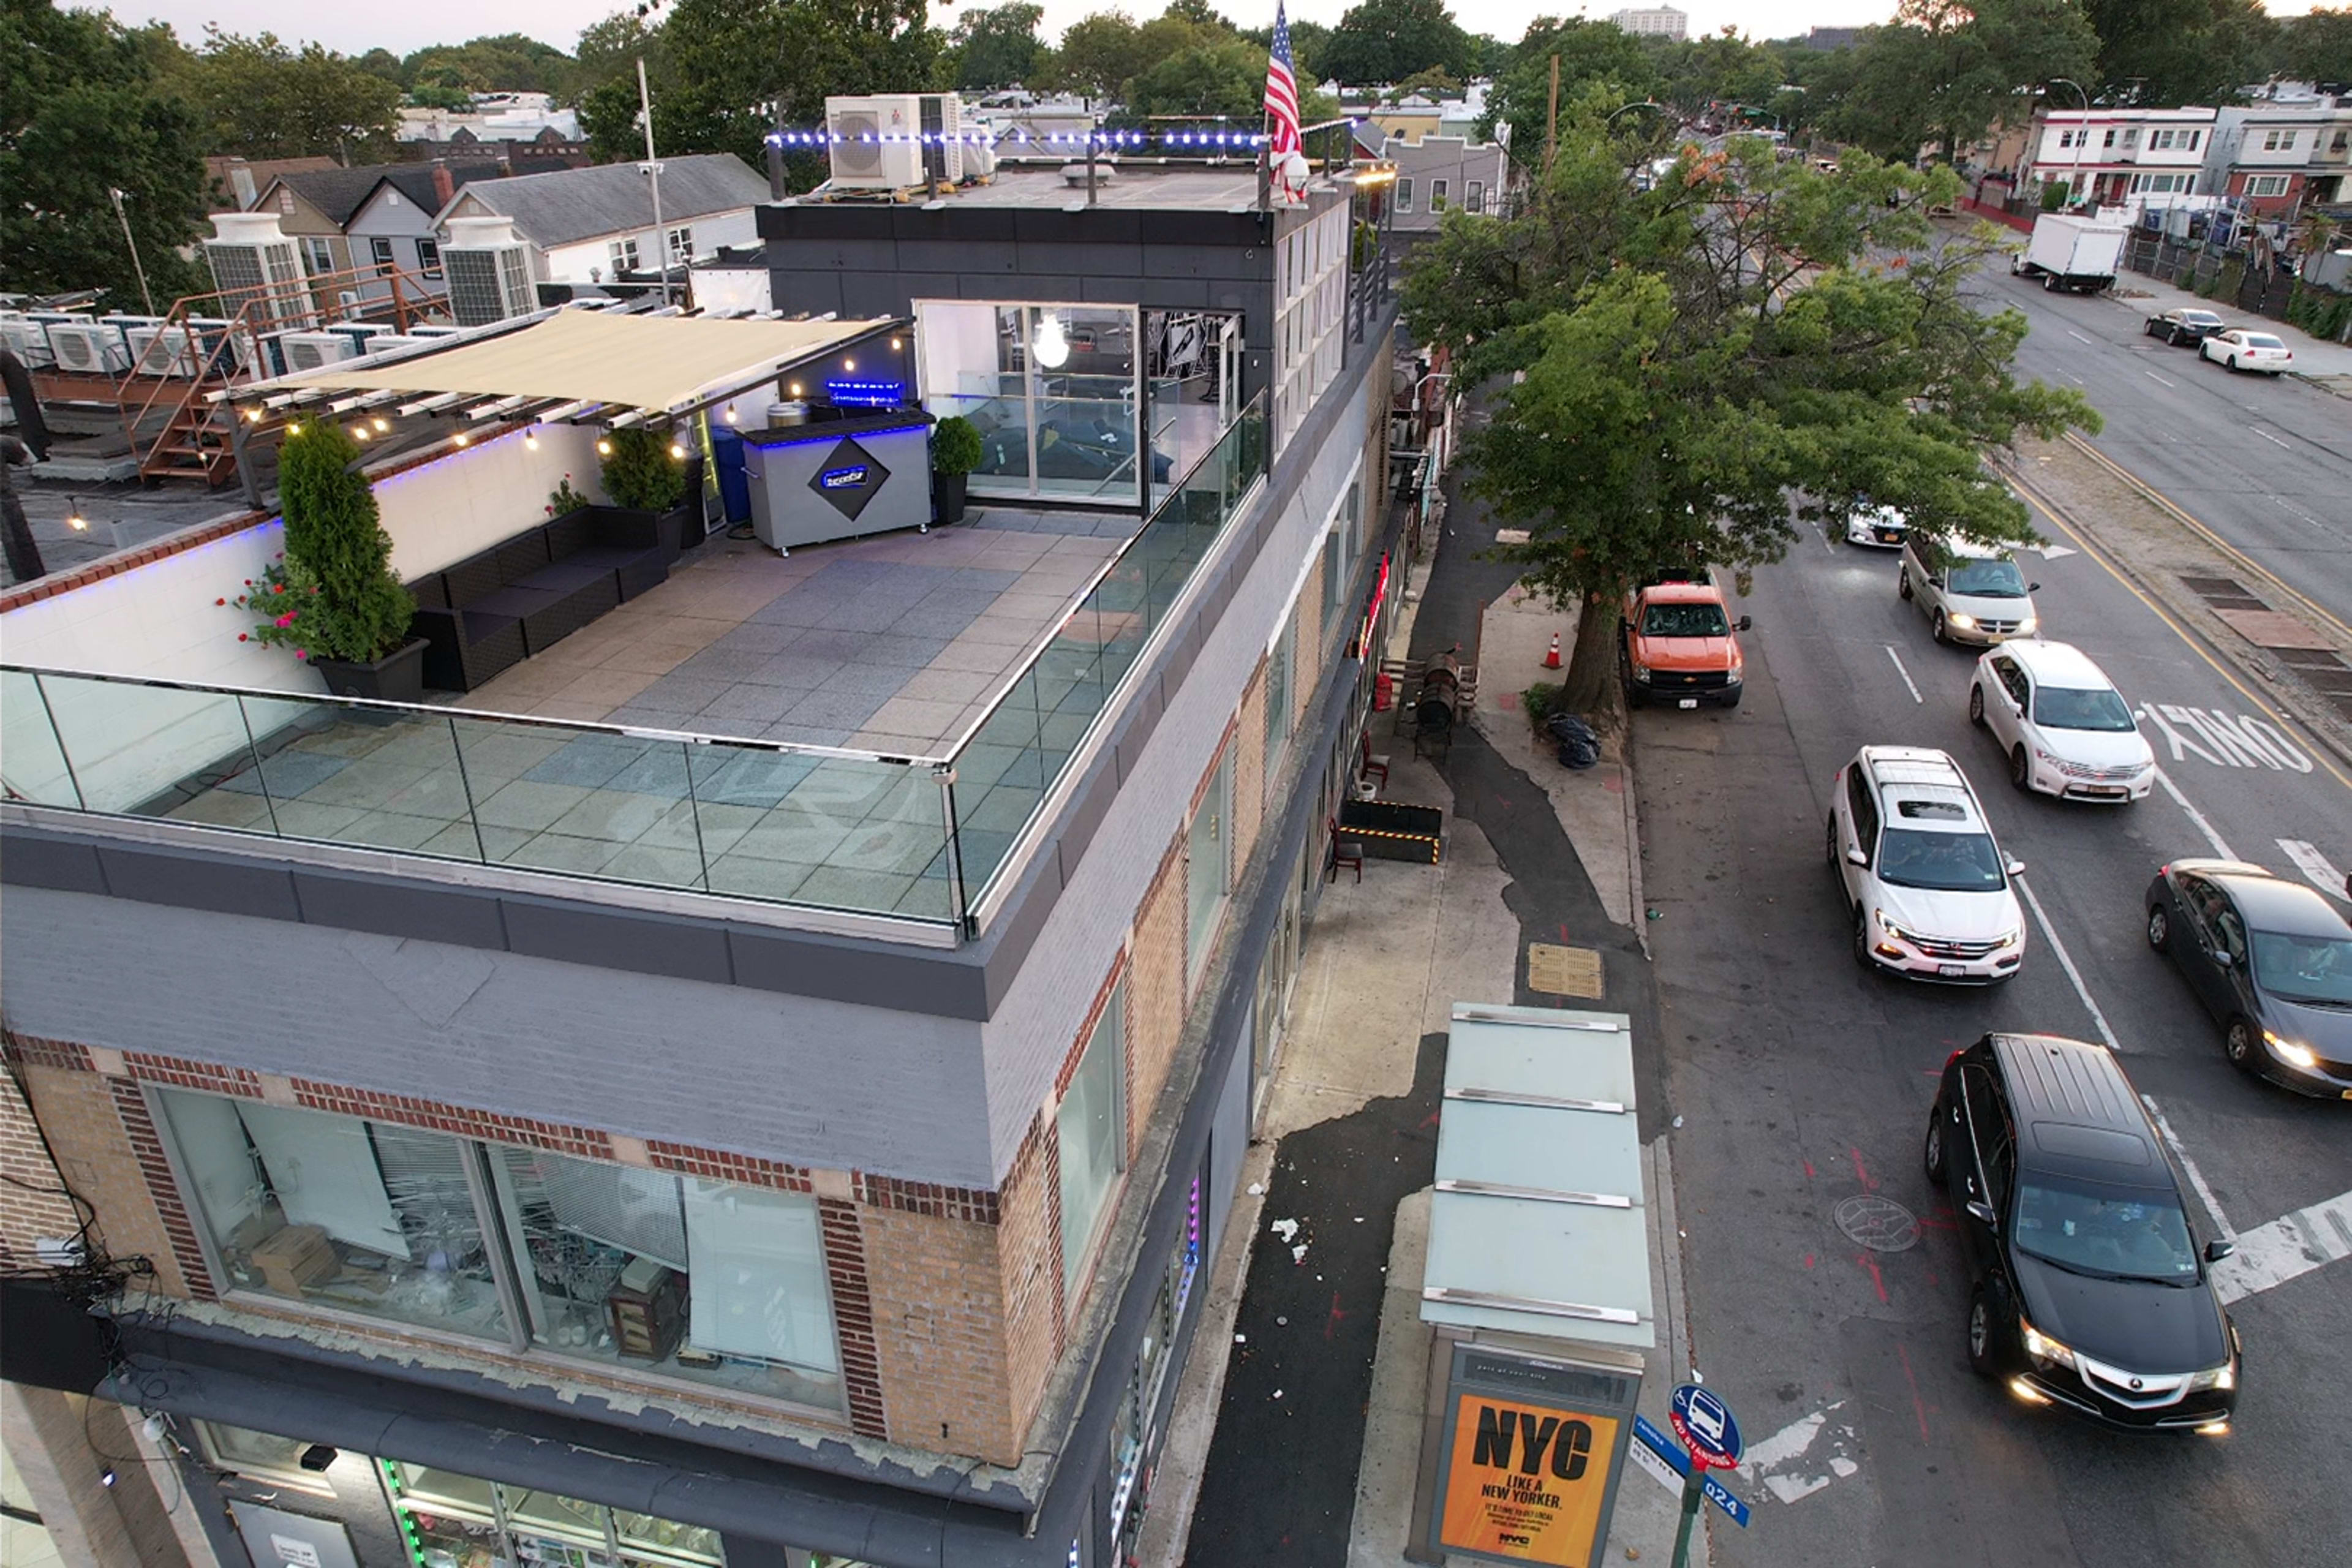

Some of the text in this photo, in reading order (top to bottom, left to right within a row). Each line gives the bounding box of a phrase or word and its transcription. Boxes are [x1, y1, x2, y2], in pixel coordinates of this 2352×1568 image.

[2141, 701, 2313, 773] ONLY
[1673, 1419, 1686, 1434] NO
[1472, 1406, 1591, 1480] NYC
[1482, 1483, 1562, 1510] NEW YORKER.
[1507, 1474, 1542, 1491] LIKE A
[1705, 1482, 1738, 1515] Q24
